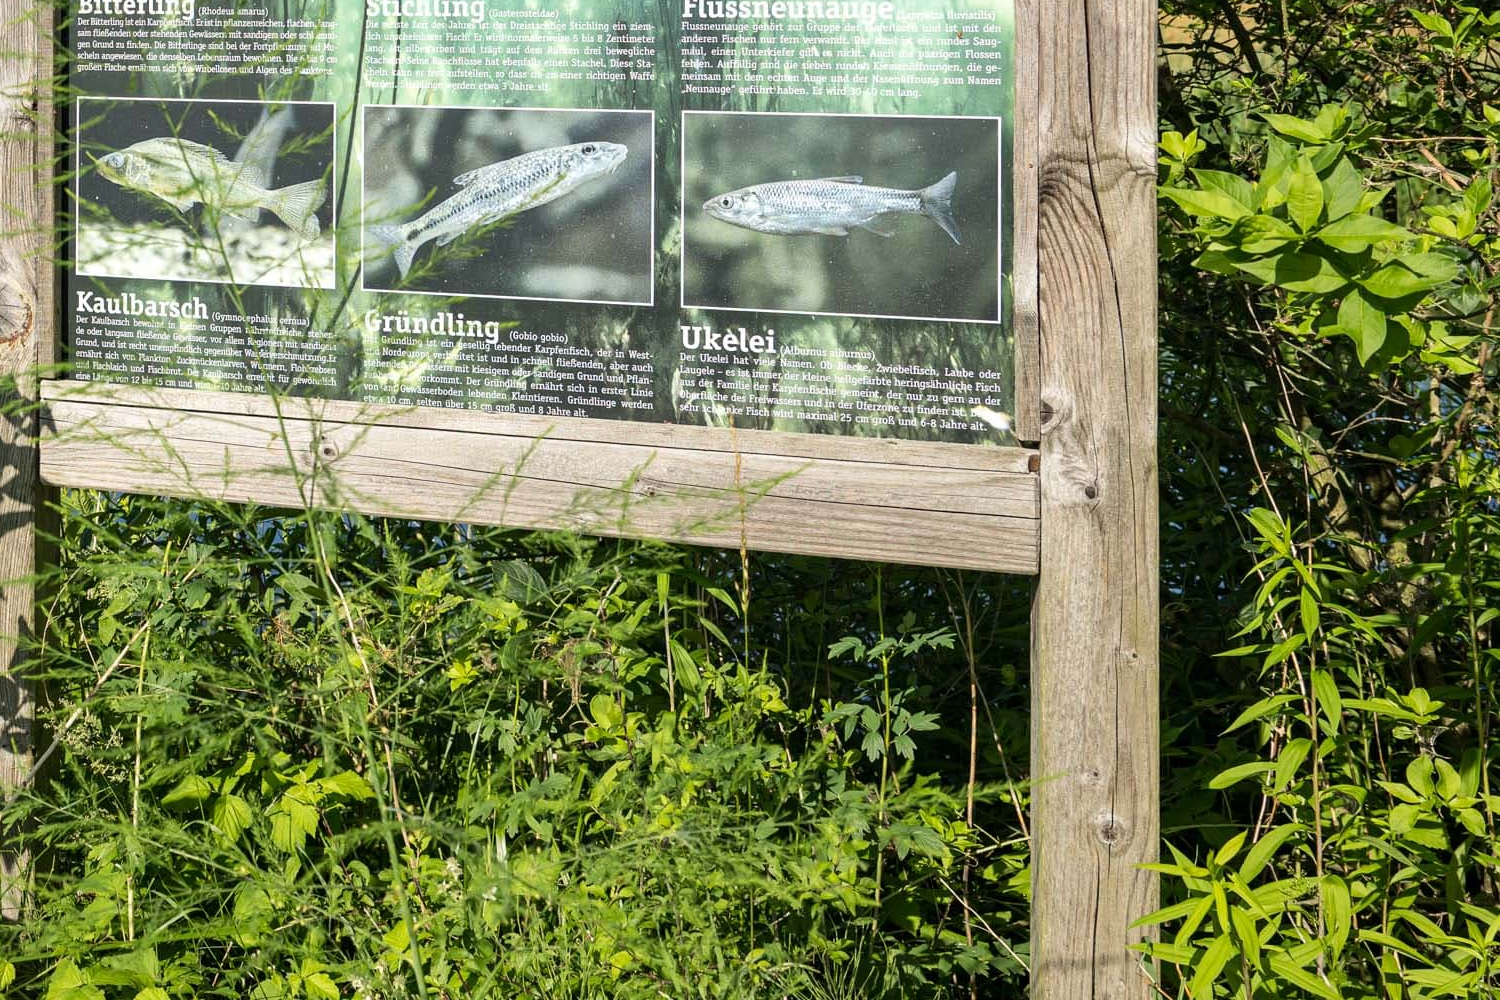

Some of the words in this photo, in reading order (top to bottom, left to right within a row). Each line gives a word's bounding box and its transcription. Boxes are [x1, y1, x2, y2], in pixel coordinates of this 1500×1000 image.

[77, 18, 90, 26] Der
[90, 18, 124, 28] Bitterling
[125, 18, 134, 26] ist
[135, 18, 146, 26] ein
[204, 18, 214, 27] ist
[223, 18, 285, 29] pflanzenreichen,
[570, 22, 609, 32] Stichling
[613, 22, 626, 31] ein
[630, 22, 655, 31] ziem-
[681, 22, 748, 33] Flussneunauge
[753, 23, 784, 33] gehört
[788, 24, 803, 32] zur
[807, 23, 841, 34] Gruppe
[963, 24, 980, 33] mit
[983, 24, 1001, 33] den
[93, 29, 131, 38] fließenden
[132, 29, 148, 38] oder
[150, 29, 187, 38] stehenden
[229, 30, 242, 39] mit
[582, 34, 594, 43] bis
[606, 35, 655, 44] Zentimeter
[681, 34, 718, 43] anderen
[721, 35, 760, 44] Fischen
[780, 35, 799, 44] fern
[973, 37, 1001, 48] Saug-
[92, 40, 114, 49] Grund
[168, 41, 207, 52] Bitterlinge
[208, 42, 224, 50] sind
[459, 45, 476, 54] und
[481, 45, 500, 56] trägt
[584, 46, 601, 55] drei
[605, 47, 655, 57] bewegliche
[77, 51, 100, 60] scheln
[159, 52, 195, 61] denselben
[681, 48, 707, 58] maul,
[711, 48, 737, 57] einen
[741, 48, 794, 57] Unterkiefer
[965, 50, 1001, 59] Flossen
[77, 62, 101, 73] großen
[105, 63, 128, 72] Fische
[162, 64, 177, 73] sich
[255, 65, 278, 76] Algen
[571, 58, 606, 67] Stachel.
[610, 59, 633, 68] Diese
[636, 59, 655, 68] Sta-
[967, 63, 982, 72] die
[985, 65, 1001, 74] ge-
[586, 71, 626, 82] richtigen
[630, 72, 655, 81] Waffe
[681, 73, 721, 82] meinsam
[968, 76, 1001, 85] Namen
[777, 87, 808, 96] haben.
[897, 88, 922, 99] lang.
[76, 291, 209, 319] Kaulbarsch
[75, 315, 88, 325] Der
[91, 316, 130, 327] Kaulbarsch
[210, 323, 242, 335] Gruppen
[364, 309, 499, 344] Gründling
[509, 331, 538, 342] (Gobio
[540, 332, 569, 344] gobio)
[86, 327, 103, 337] oder
[105, 328, 134, 340] langsam
[210, 336, 222, 344] vor
[225, 336, 245, 345] allem
[75, 338, 99, 349] Grund,
[101, 339, 116, 349] und
[117, 340, 127, 349] ist
[129, 341, 147, 351] recht
[426, 338, 438, 347] ist
[494, 342, 531, 353] lebender
[535, 344, 593, 358] Karpfenfisch,
[629, 350, 654, 360] West-
[75, 350, 103, 360] ernährt
[105, 352, 119, 361] sich
[780, 345, 827, 357] (Alburnus
[829, 346, 876, 360] alburnus)
[522, 356, 553, 366] schnell
[556, 358, 606, 371] fließenden,
[609, 361, 629, 371] aber
[632, 363, 654, 372] auch
[700, 354, 729, 364] Ukelei
[753, 357, 776, 367] viele
[780, 358, 815, 369] Namen.
[876, 364, 939, 377] Zwiebelfisch,
[945, 367, 974, 378] Laube
[979, 369, 1001, 379] oder
[75, 371, 91, 381] eine
[178, 378, 193, 387] und
[130, 364, 145, 373] und
[278, 374, 290, 383] für
[472, 365, 510, 377] kiesigem
[577, 371, 604, 381] Grund
[626, 374, 654, 384] Pflan-
[680, 365, 715, 377] Laugele
[752, 369, 782, 379] immer
[802, 372, 831, 382] kleine
[834, 374, 892, 388] hellgefärbte
[894, 378, 973, 393] heringsähnliche
[975, 383, 1001, 393] Fisch
[530, 381, 564, 391] ernährt
[567, 383, 585, 393] sich
[601, 385, 628, 395] erster
[631, 387, 654, 397] Linie
[717, 380, 750, 391] Familie
[772, 383, 836, 398] Karpfenfische
[841, 388, 883, 400] gemeint,
[942, 395, 965, 405] gern
[400, 385, 464, 397] Gewässerboden
[468, 389, 507, 400] lebenden
[512, 392, 563, 404] Kleintieren.
[567, 395, 617, 409] Gründlinge
[621, 399, 654, 410] werden
[749, 394, 801, 406] Freiwassers
[856, 401, 900, 412] Uferzone
[917, 405, 949, 415] finden
[445, 399, 464, 409] über
[495, 403, 516, 414] groß
[546, 406, 571, 416] Jahre
[574, 408, 589, 417] alt.
[680, 402, 700, 412] sehr
[746, 407, 770, 417] Fisch
[772, 408, 794, 418] wird
[797, 410, 837, 421] maximal
[940, 419, 968, 430] Jahre
